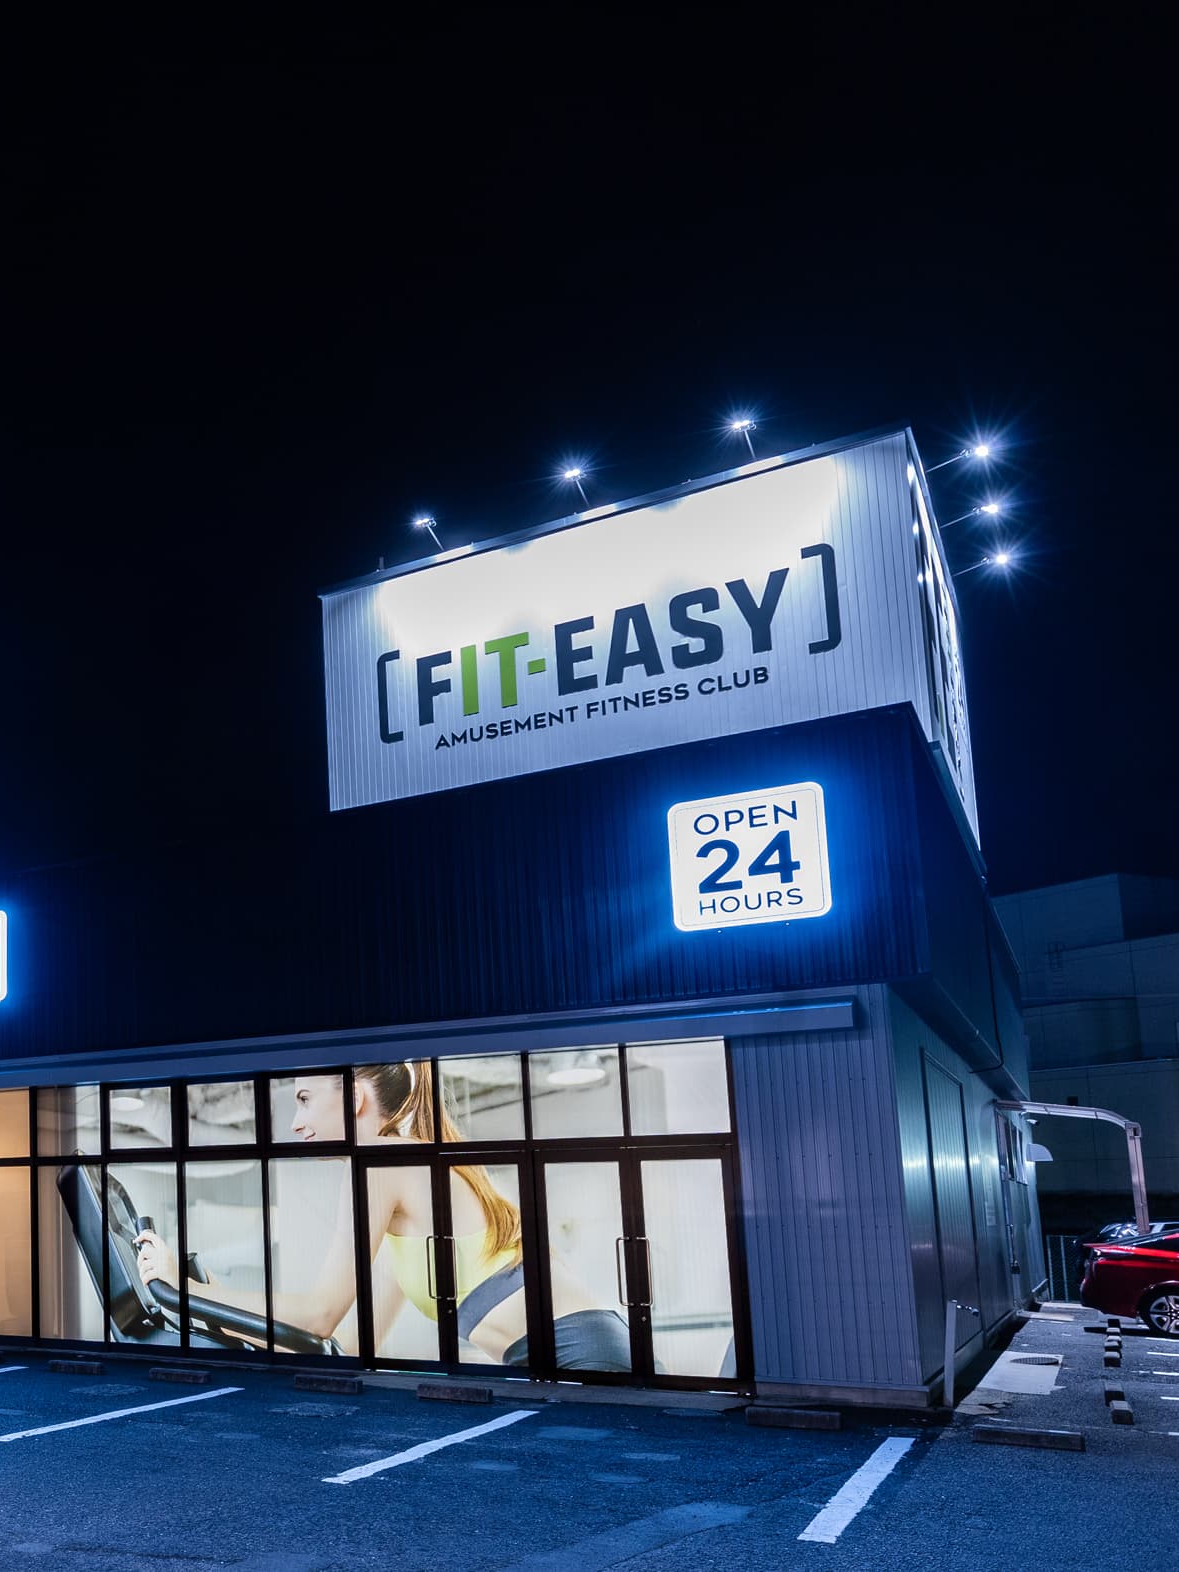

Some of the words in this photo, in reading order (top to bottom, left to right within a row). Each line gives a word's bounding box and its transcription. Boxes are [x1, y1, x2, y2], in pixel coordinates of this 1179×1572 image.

[435, 706, 578, 750] AMUSEMENT
[587, 683, 689, 719] FITNESS
[697, 666, 769, 695] CLUB
[693, 800, 798, 835] OPEN
[696, 830, 801, 894] 24
[699, 888, 804, 916] HOURS
